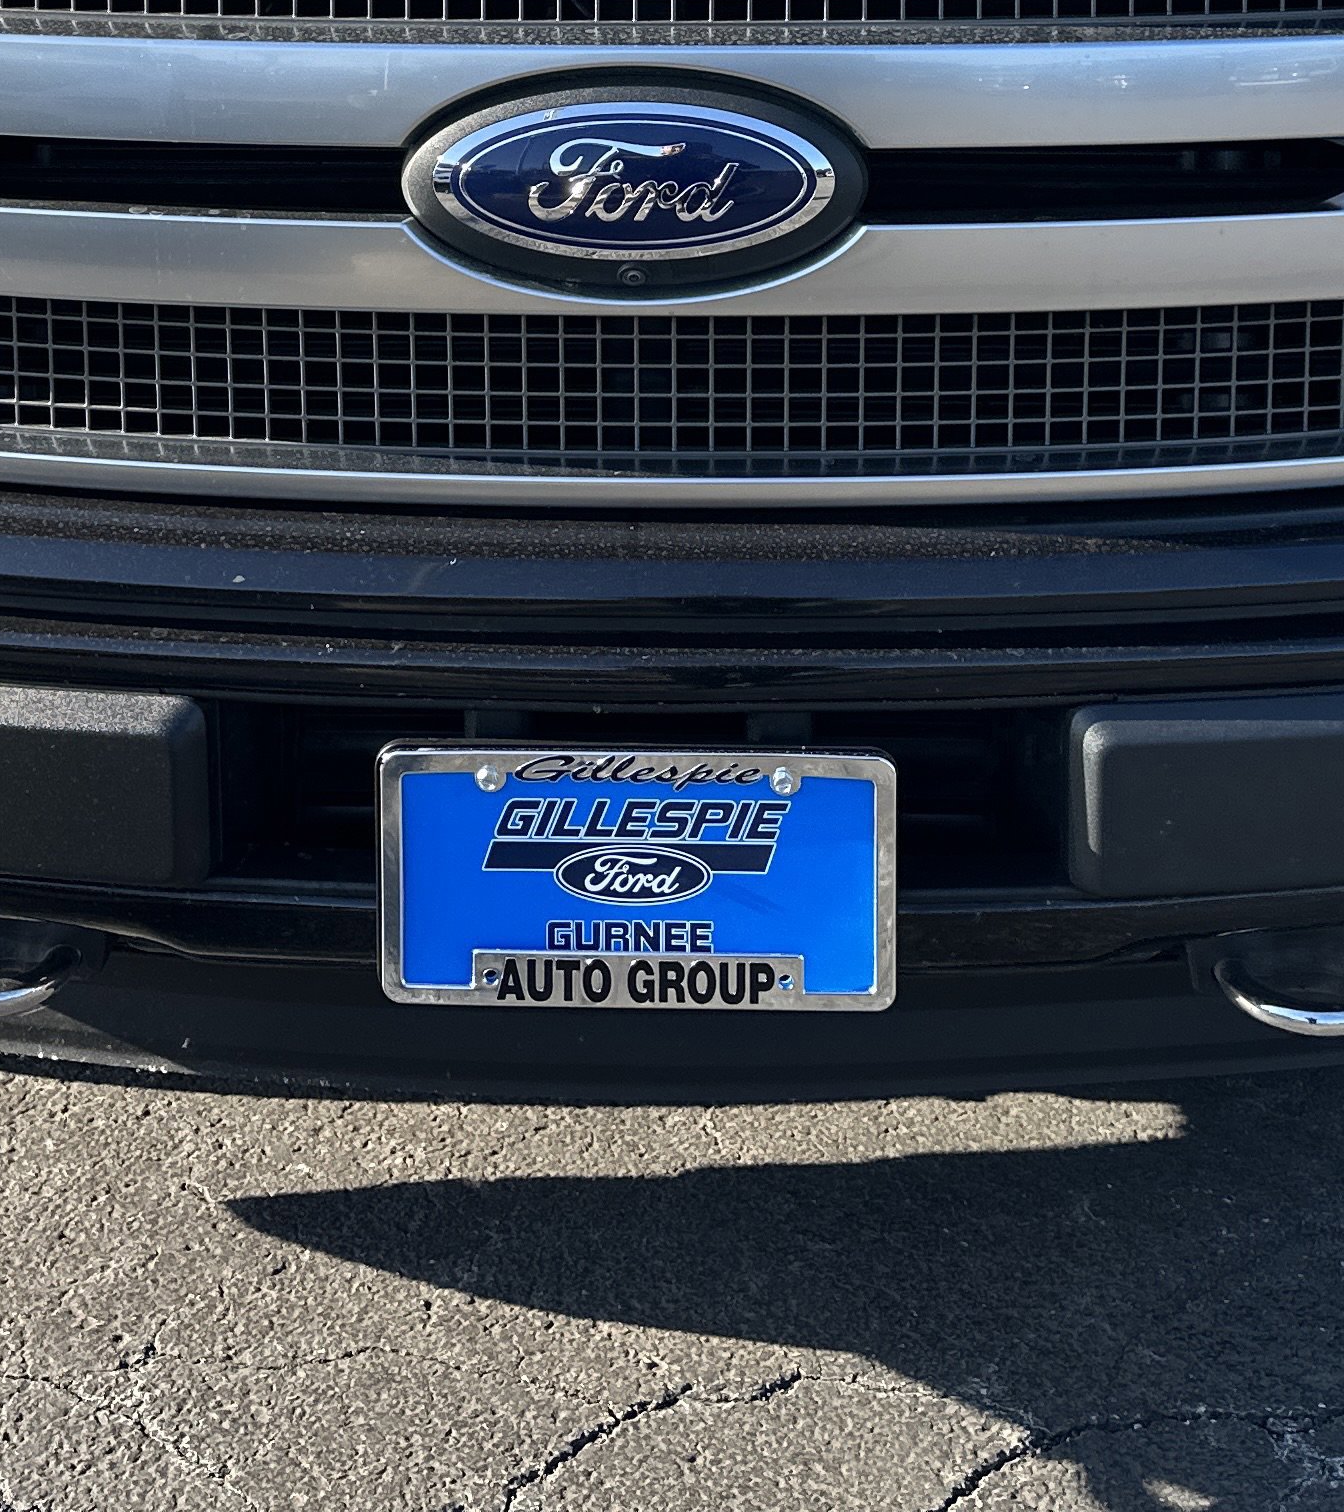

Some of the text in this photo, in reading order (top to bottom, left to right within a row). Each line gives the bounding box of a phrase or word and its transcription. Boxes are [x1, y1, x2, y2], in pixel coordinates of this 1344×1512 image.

[528, 137, 740, 223] Ford
[513, 754, 762, 792] Gillespie
[494, 797, 792, 841] GILLESPIE
[583, 854, 681, 894] Ford
[546, 919, 714, 954] GURNEE
[496, 958, 776, 1006] AUTO GROUP
